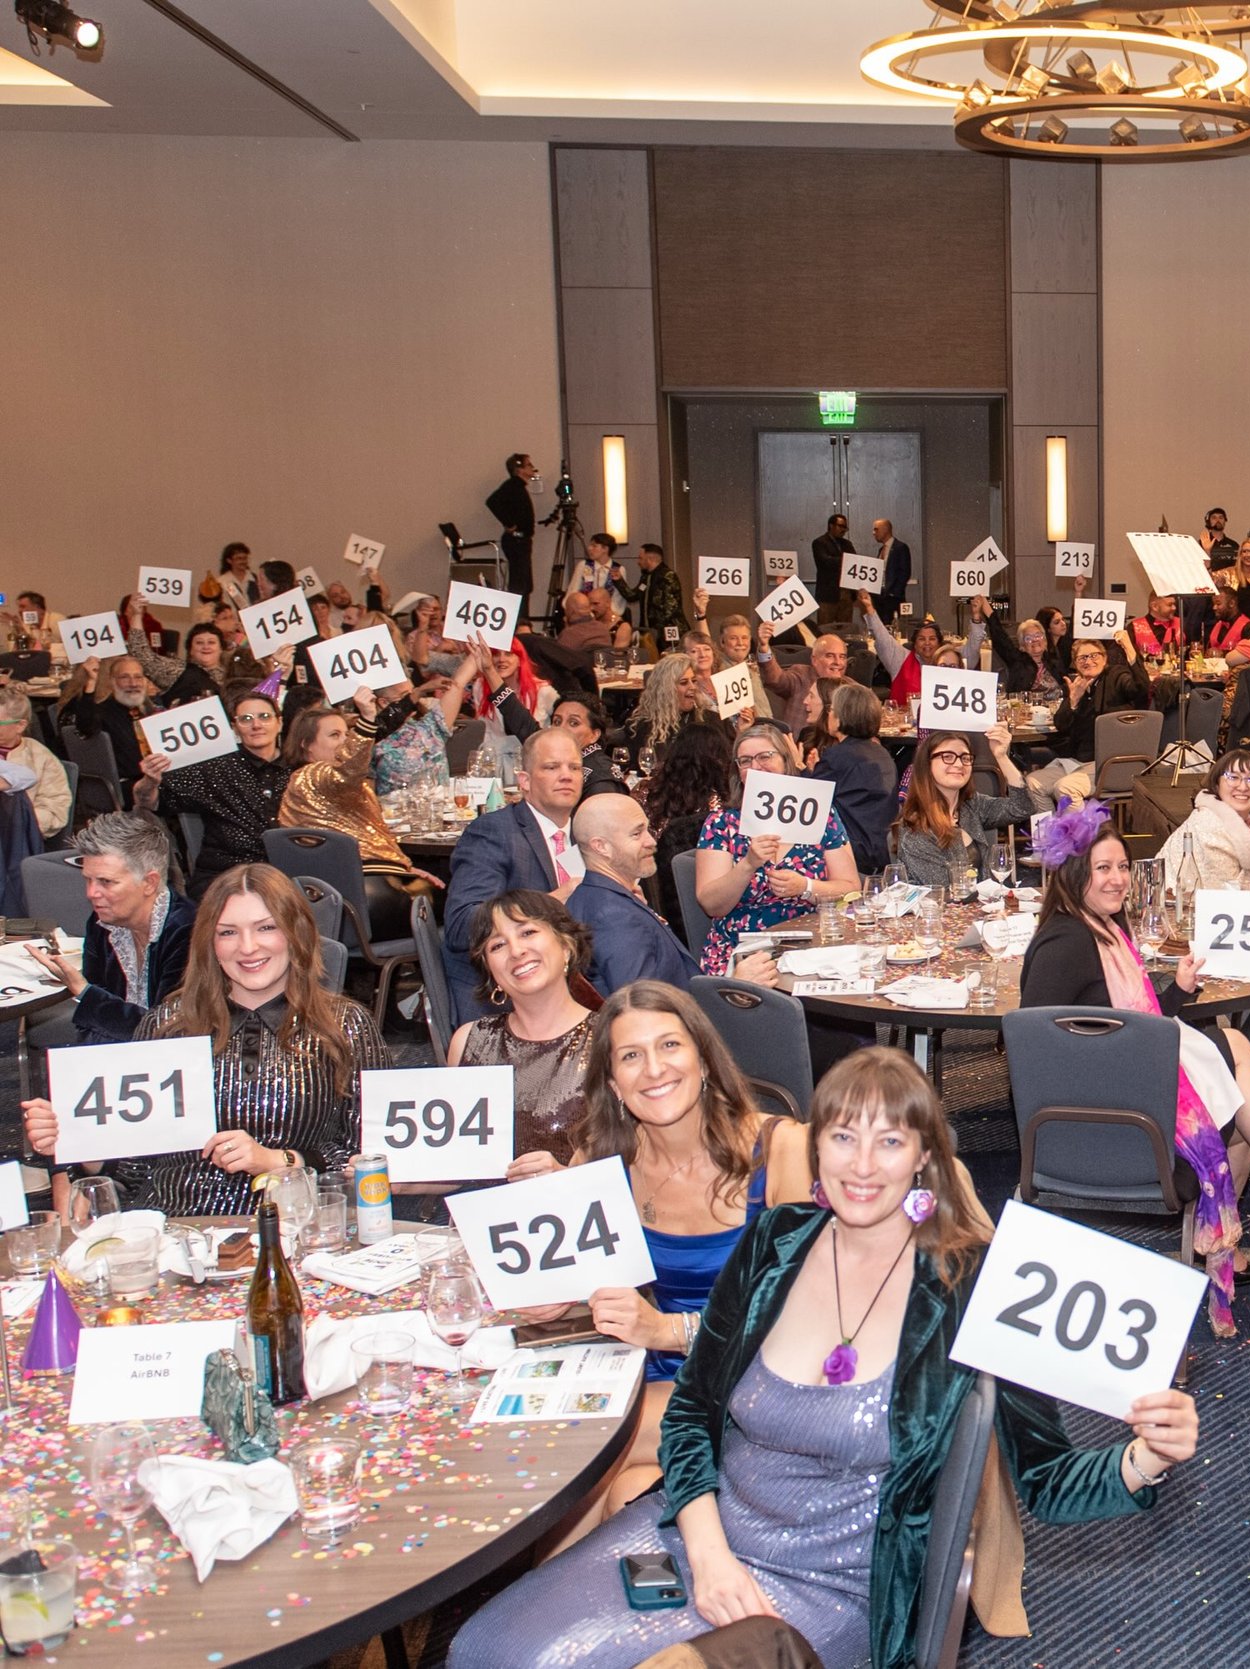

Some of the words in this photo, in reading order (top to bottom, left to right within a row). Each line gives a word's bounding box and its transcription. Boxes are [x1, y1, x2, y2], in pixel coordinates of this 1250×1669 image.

[769, 557, 794, 570] 532
[847, 563, 878, 583] 453
[1061, 551, 1090, 568] 213
[145, 577, 183, 596] 539
[705, 567, 742, 586] 266
[956, 570, 986, 586] 660
[455, 600, 507, 632] 469
[770, 589, 805, 622] 430
[1081, 609, 1118, 628] 549
[256, 604, 303, 640] 154
[70, 624, 115, 650] 194
[329, 643, 389, 680] 404
[724, 677, 748, 704] 567
[932, 683, 987, 714] 548
[160, 715, 220, 753] 506
[753, 790, 819, 826] 360
[73, 1069, 185, 1126] 451
[384, 1097, 494, 1149] 594
[488, 1200, 620, 1275] 524
[995, 1261, 1157, 1371] 203
[133, 1352, 163, 1362] Table
[165, 1351, 172, 1360] 7
[130, 1368, 170, 1379] AirBNB
